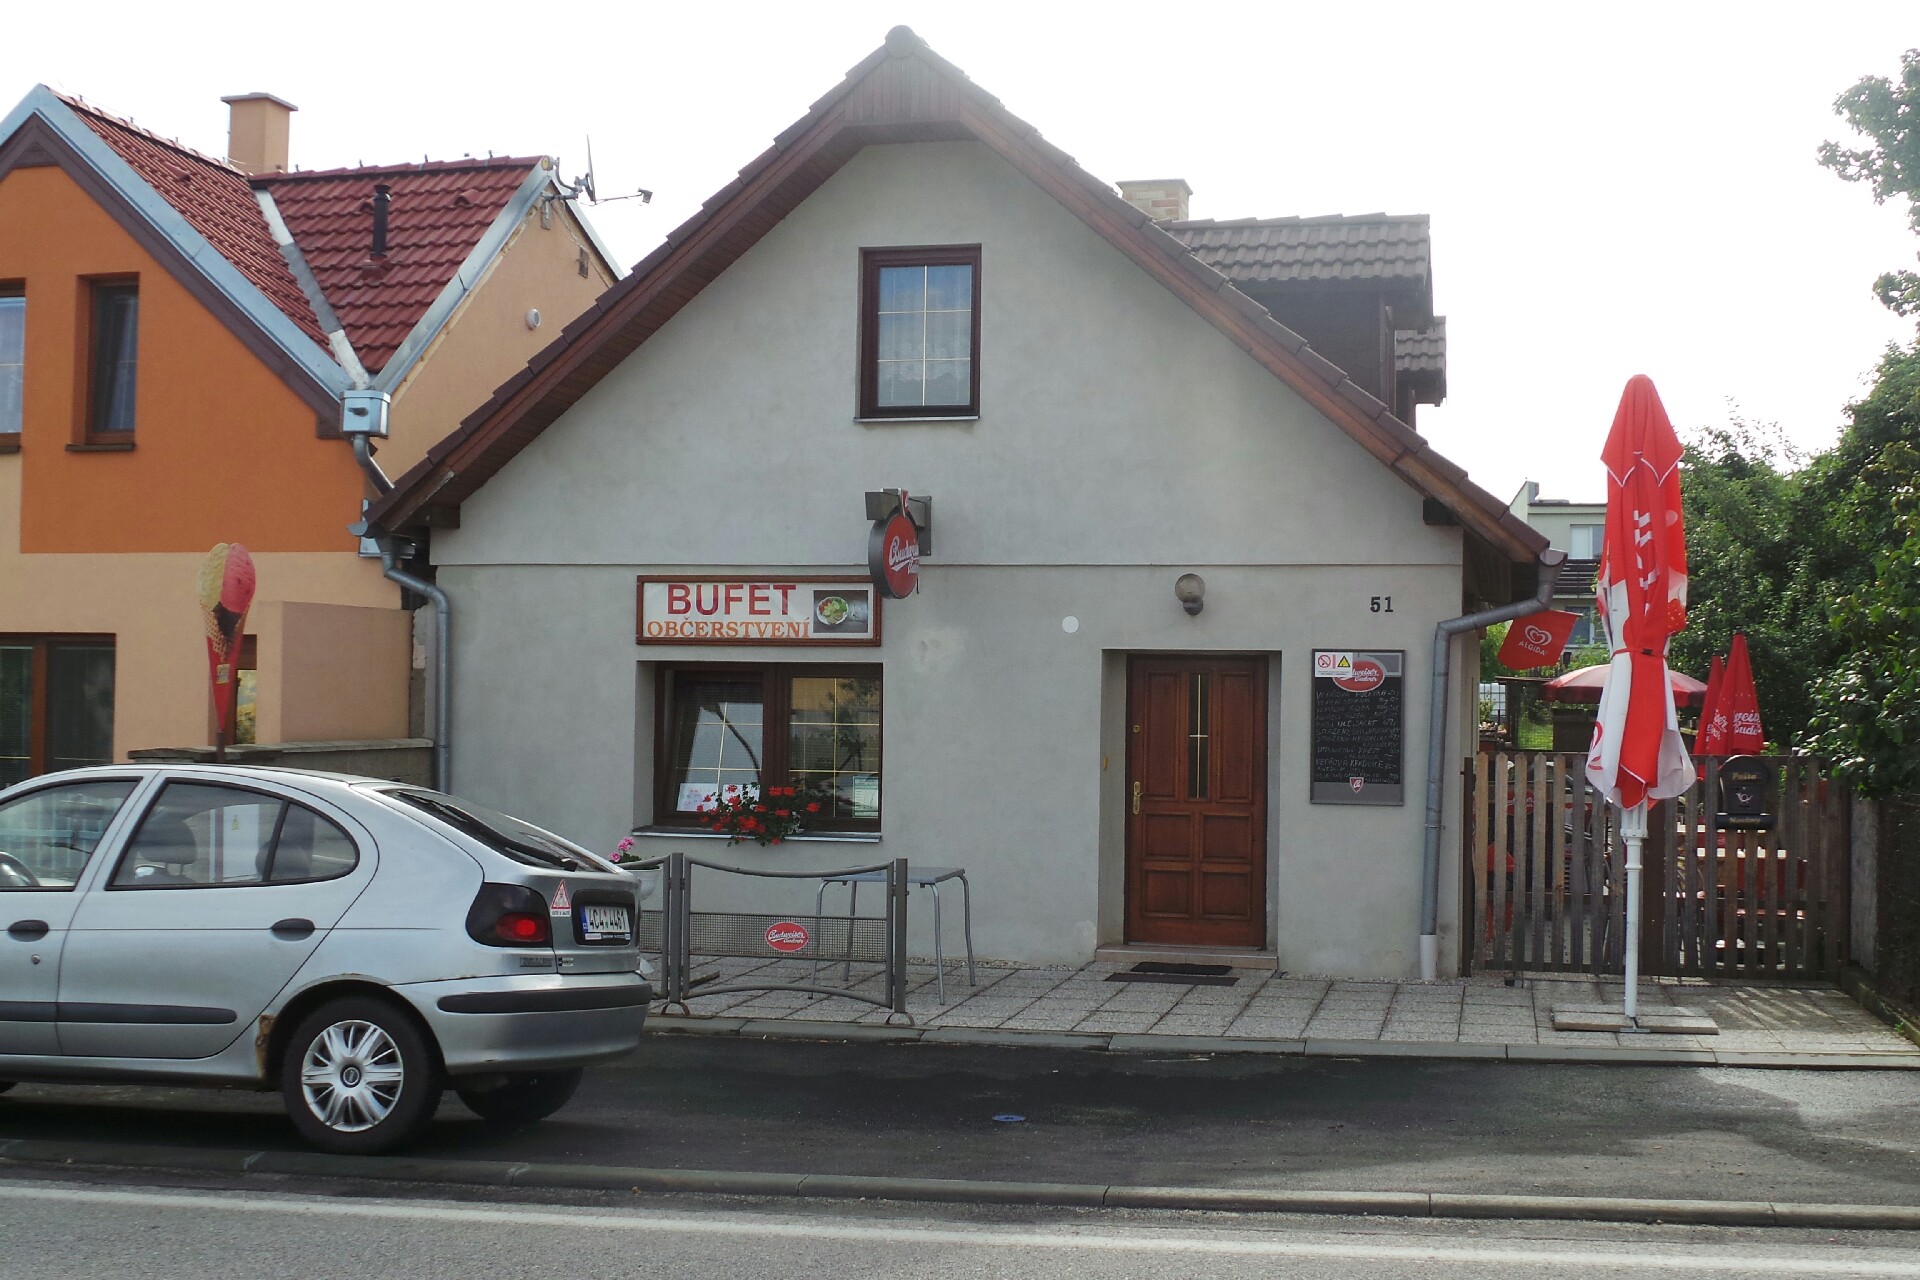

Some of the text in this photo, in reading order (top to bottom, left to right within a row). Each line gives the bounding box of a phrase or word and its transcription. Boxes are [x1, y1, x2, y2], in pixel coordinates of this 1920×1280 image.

[667, 584, 797, 616] BUFET
[1370, 596, 1394, 613] 51
[646, 617, 811, 639] OBČERSTVENÍ
[1518, 641, 1546, 656] ALGIDA
